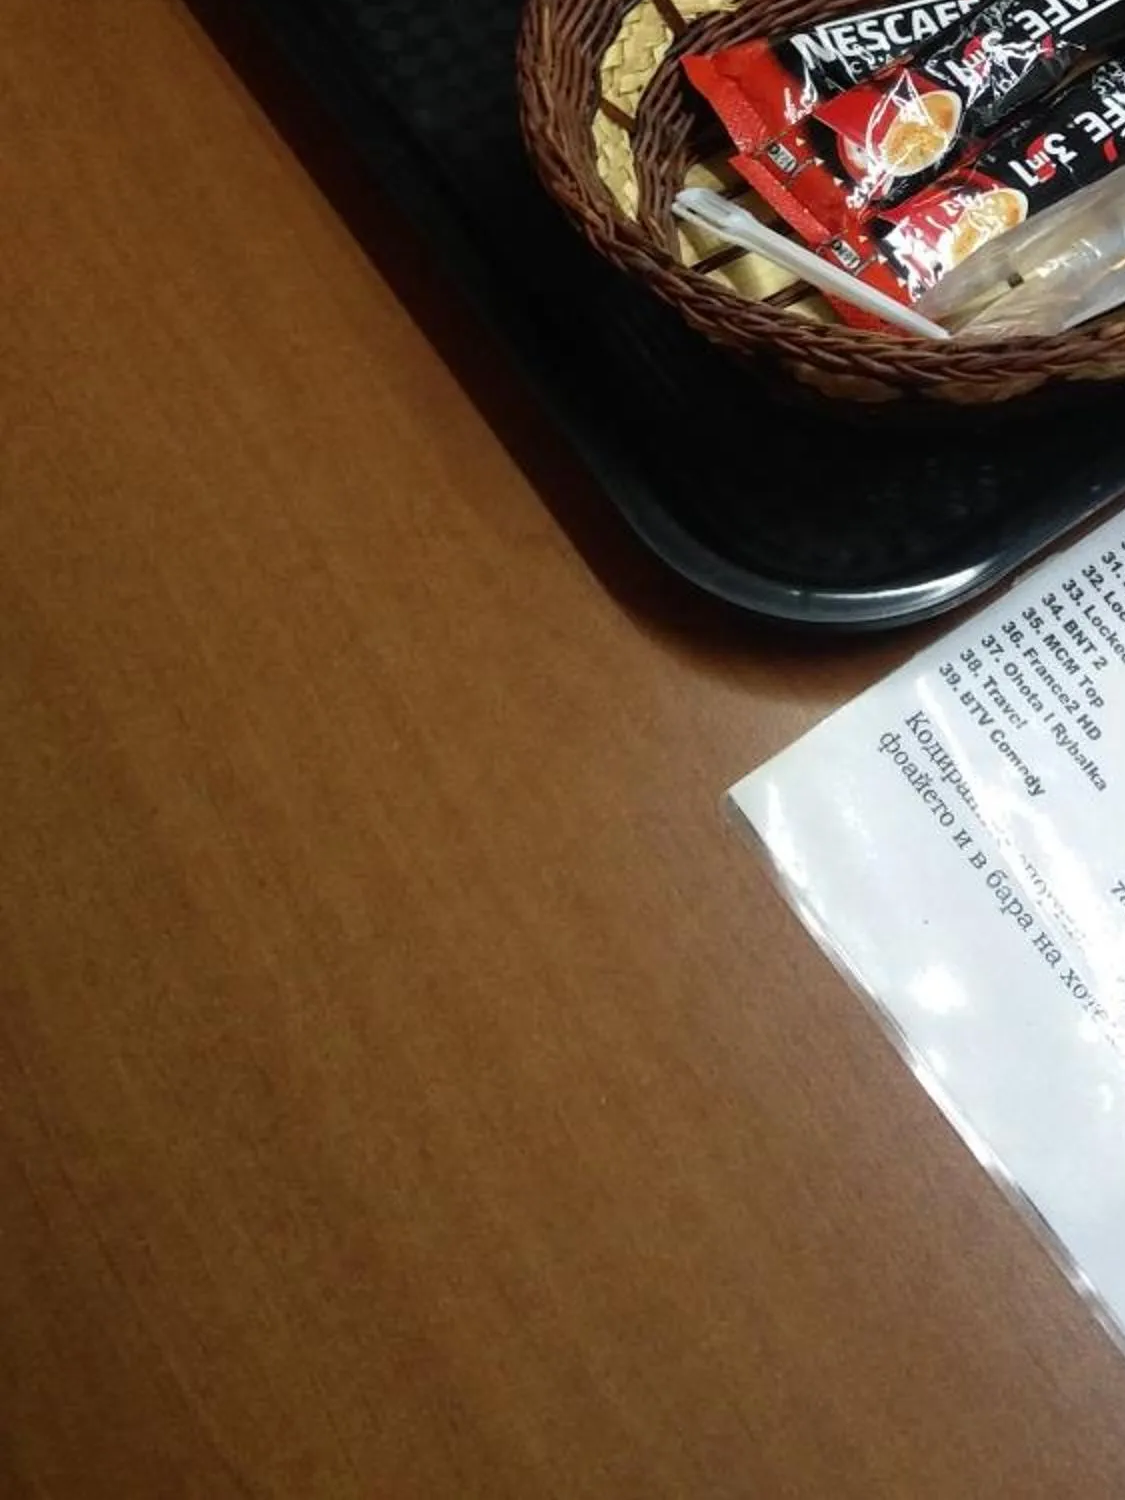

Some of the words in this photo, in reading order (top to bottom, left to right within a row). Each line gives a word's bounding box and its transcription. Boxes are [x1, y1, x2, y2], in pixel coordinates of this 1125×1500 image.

[1060, 578, 1087, 608] 33.
[1081, 564, 1107, 593] 32.
[1100, 550, 1125, 579] 31.
[958, 648, 985, 679] 38.
[1020, 606, 1046, 636] 35.
[1041, 632, 1082, 676] MCM
[1075, 673, 1106, 710] Top
[1040, 592, 1067, 622] 34.
[1061, 617, 1099, 656] BNT
[1091, 655, 1109, 671] 2
[937, 662, 963, 693] 39.
[958, 689, 996, 728] BTV
[979, 633, 1007, 664] 37.
[1001, 660, 1046, 713] Ohota
[1049, 721, 1109, 793] Rybalka
[1000, 619, 1027, 650] 36.
[1021, 646, 1081, 716] France2
[1075, 713, 1103, 741] HD
[875, 730, 958, 829] фоайето
[951, 827, 974, 851] и
[967, 848, 991, 870] в
[983, 868, 1037, 934] бара
[1030, 927, 1064, 970] на
